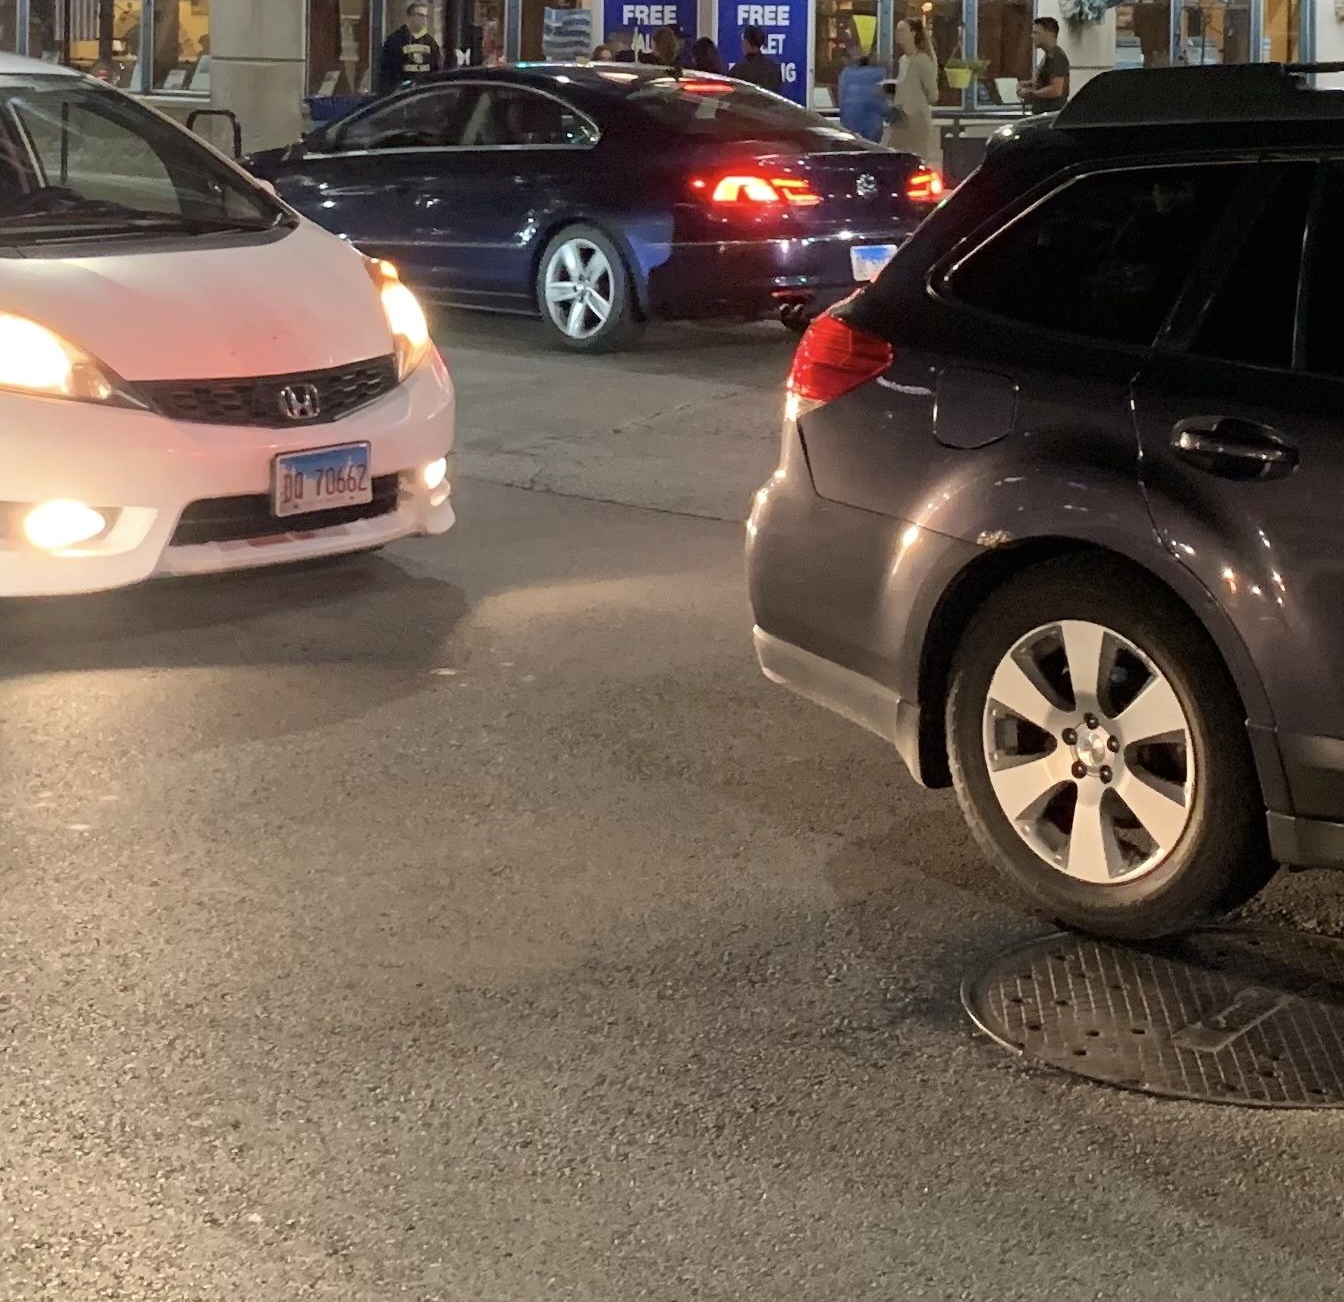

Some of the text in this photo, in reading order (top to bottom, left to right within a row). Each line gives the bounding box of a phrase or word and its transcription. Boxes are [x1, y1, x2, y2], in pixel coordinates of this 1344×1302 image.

[622, 4, 677, 26] FREE
[737, 4, 790, 27] FREE
[314, 463, 367, 496] 70662
